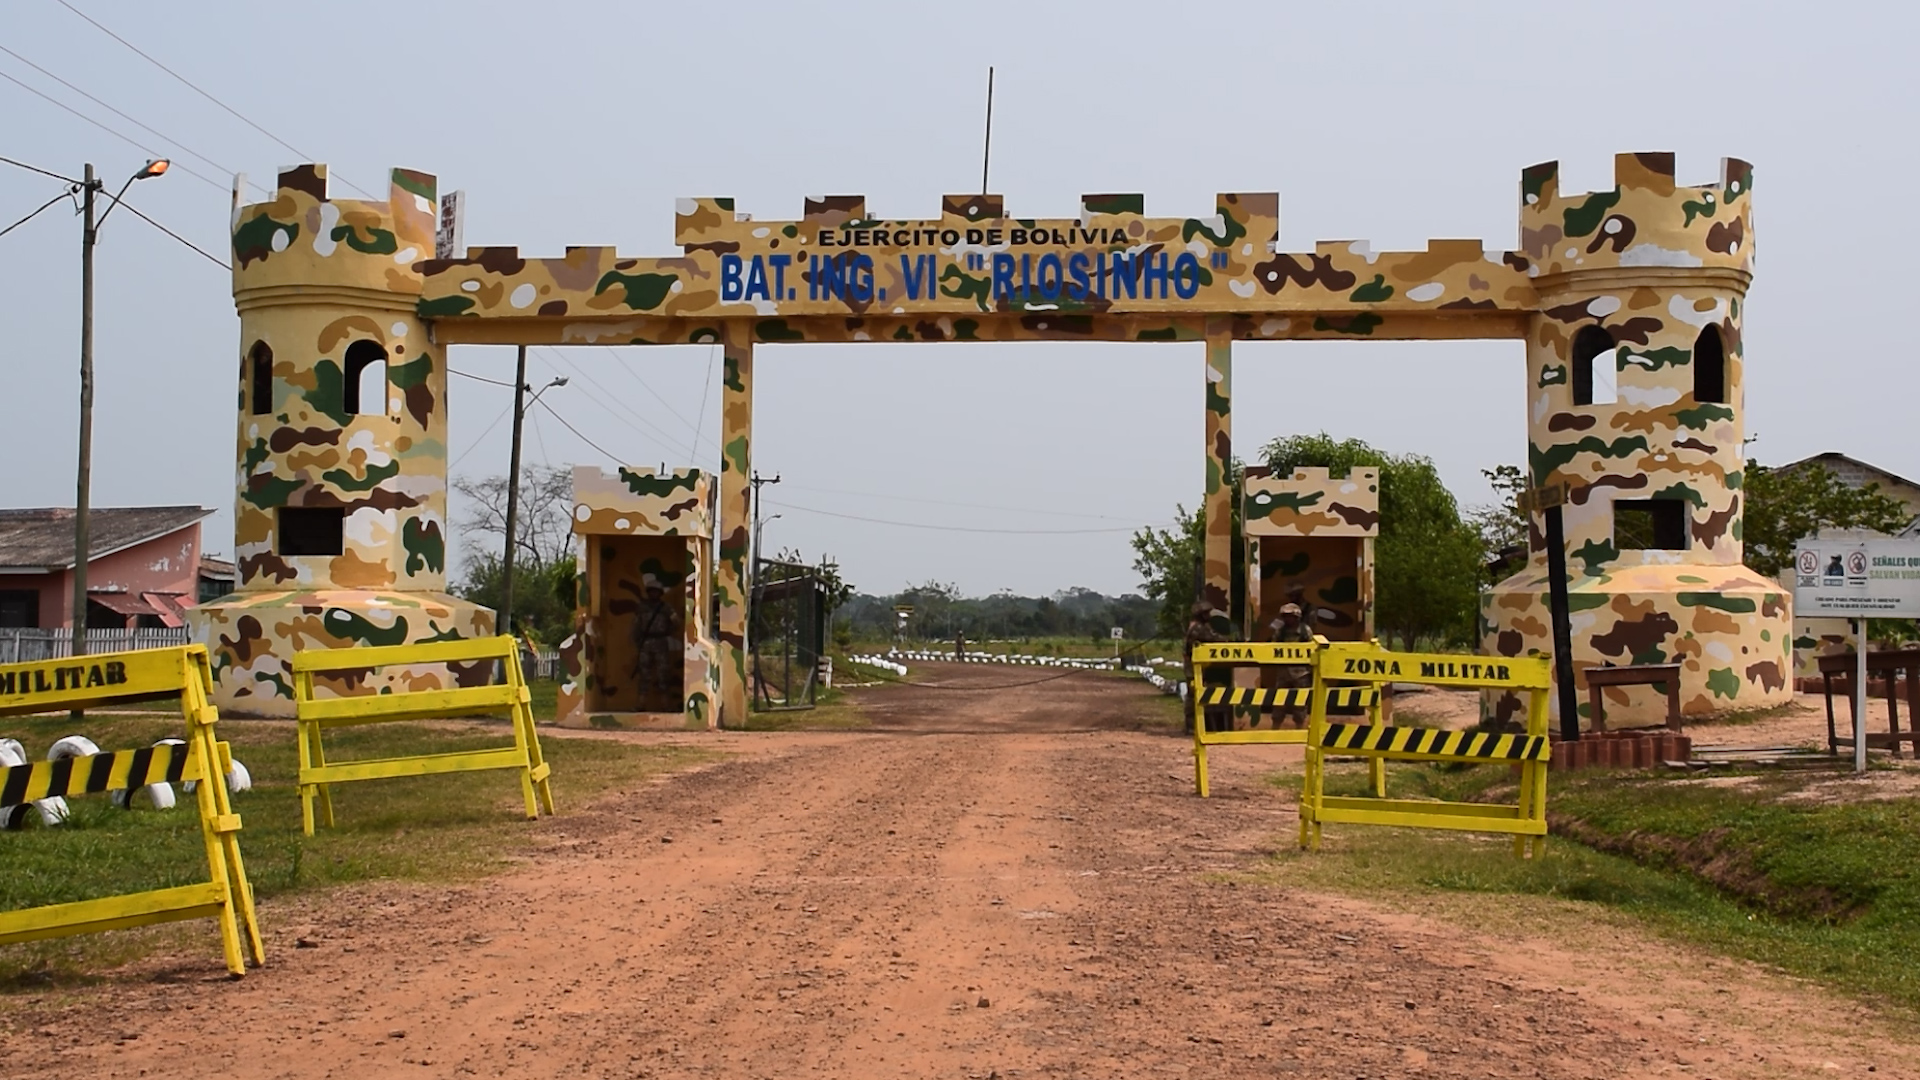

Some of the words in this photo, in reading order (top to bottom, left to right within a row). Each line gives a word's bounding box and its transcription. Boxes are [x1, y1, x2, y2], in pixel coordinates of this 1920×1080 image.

[819, 229, 960, 247] EJERCITO
[966, 229, 1003, 246] DE
[1010, 228, 1129, 246] BOLIVIA
[721, 254, 797, 301] BAT.
[809, 254, 887, 301] ING.
[901, 254, 937, 300] VI
[1872, 555, 1906, 567] SEÑALES
[1869, 570, 1900, 580] SALVAN
[1209, 648, 1254, 659] ZONA
[1344, 658, 1402, 676] ZONA
[1421, 662, 1511, 681] MILITAR
